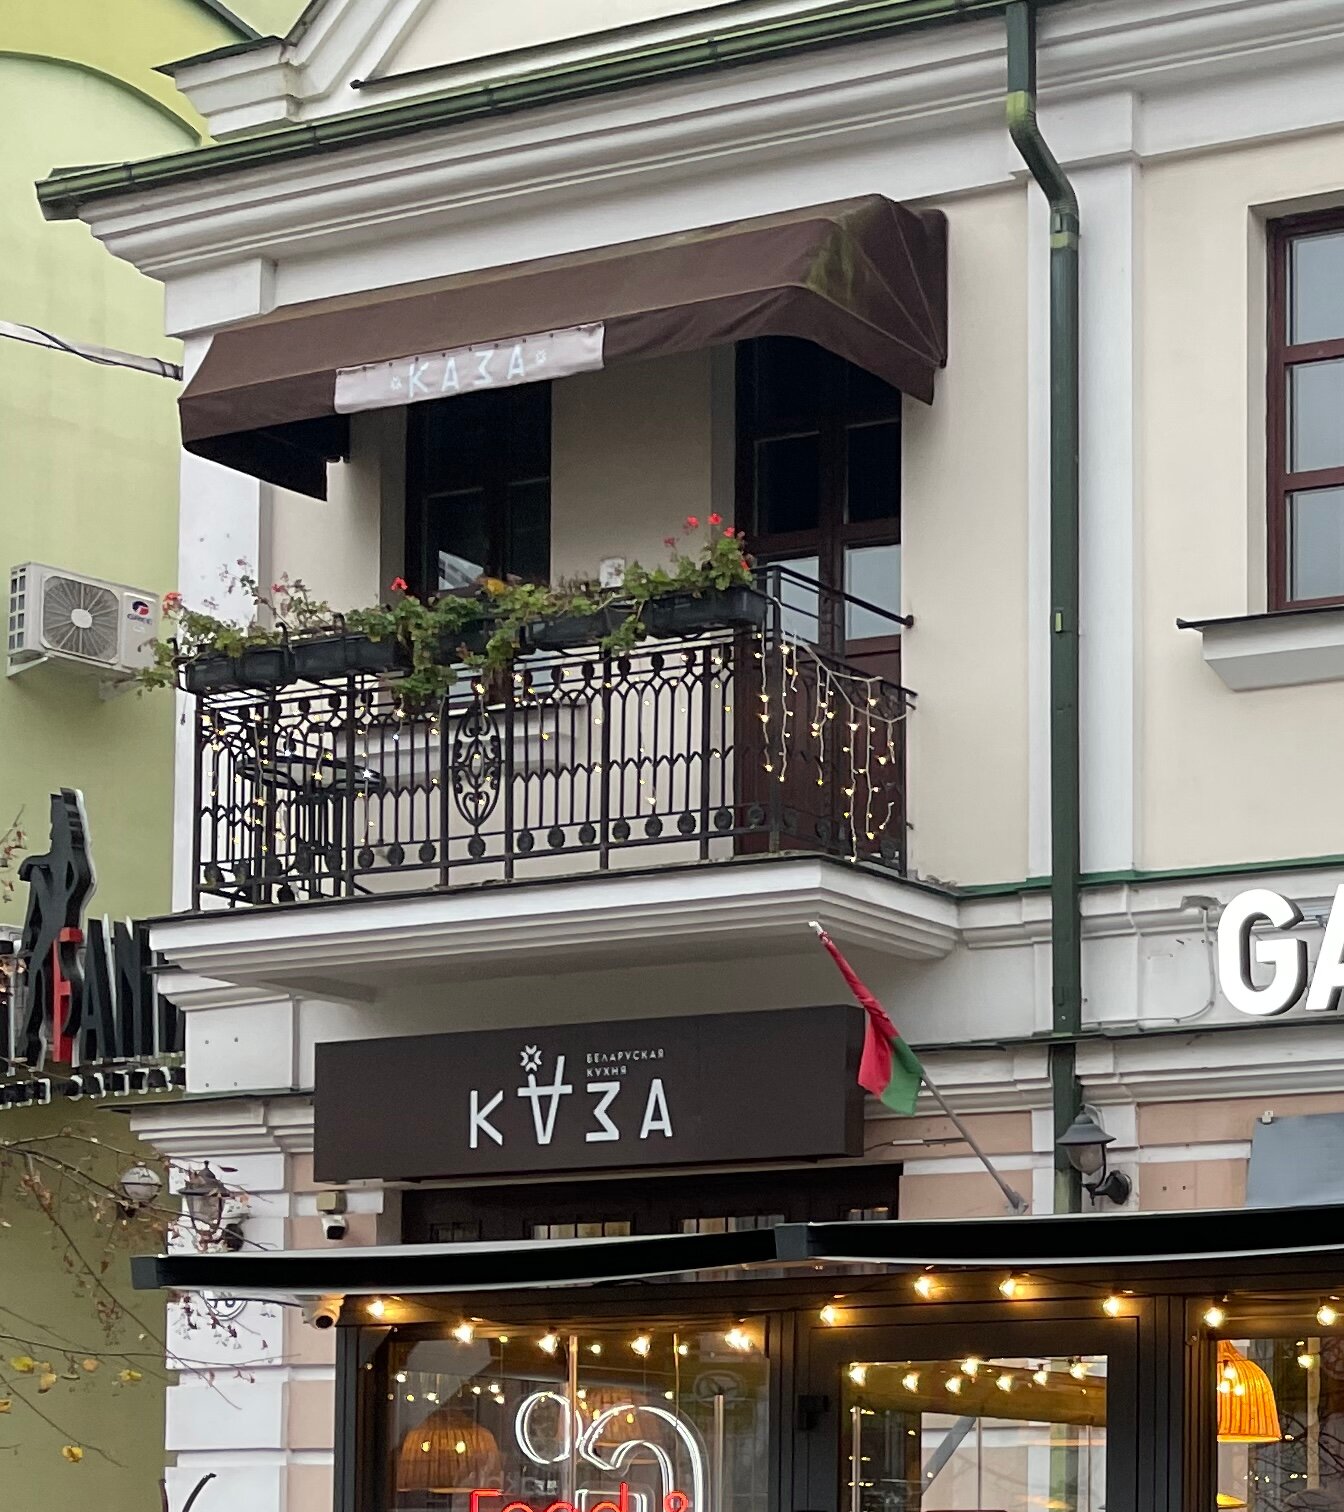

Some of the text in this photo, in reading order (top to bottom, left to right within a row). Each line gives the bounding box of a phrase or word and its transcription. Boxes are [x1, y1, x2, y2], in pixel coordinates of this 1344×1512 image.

[407, 344, 525, 398] КАЗА
[586, 1048, 665, 1064] БЕЛАРУСКАЯ
[586, 1065, 627, 1078] КУХНЯ
